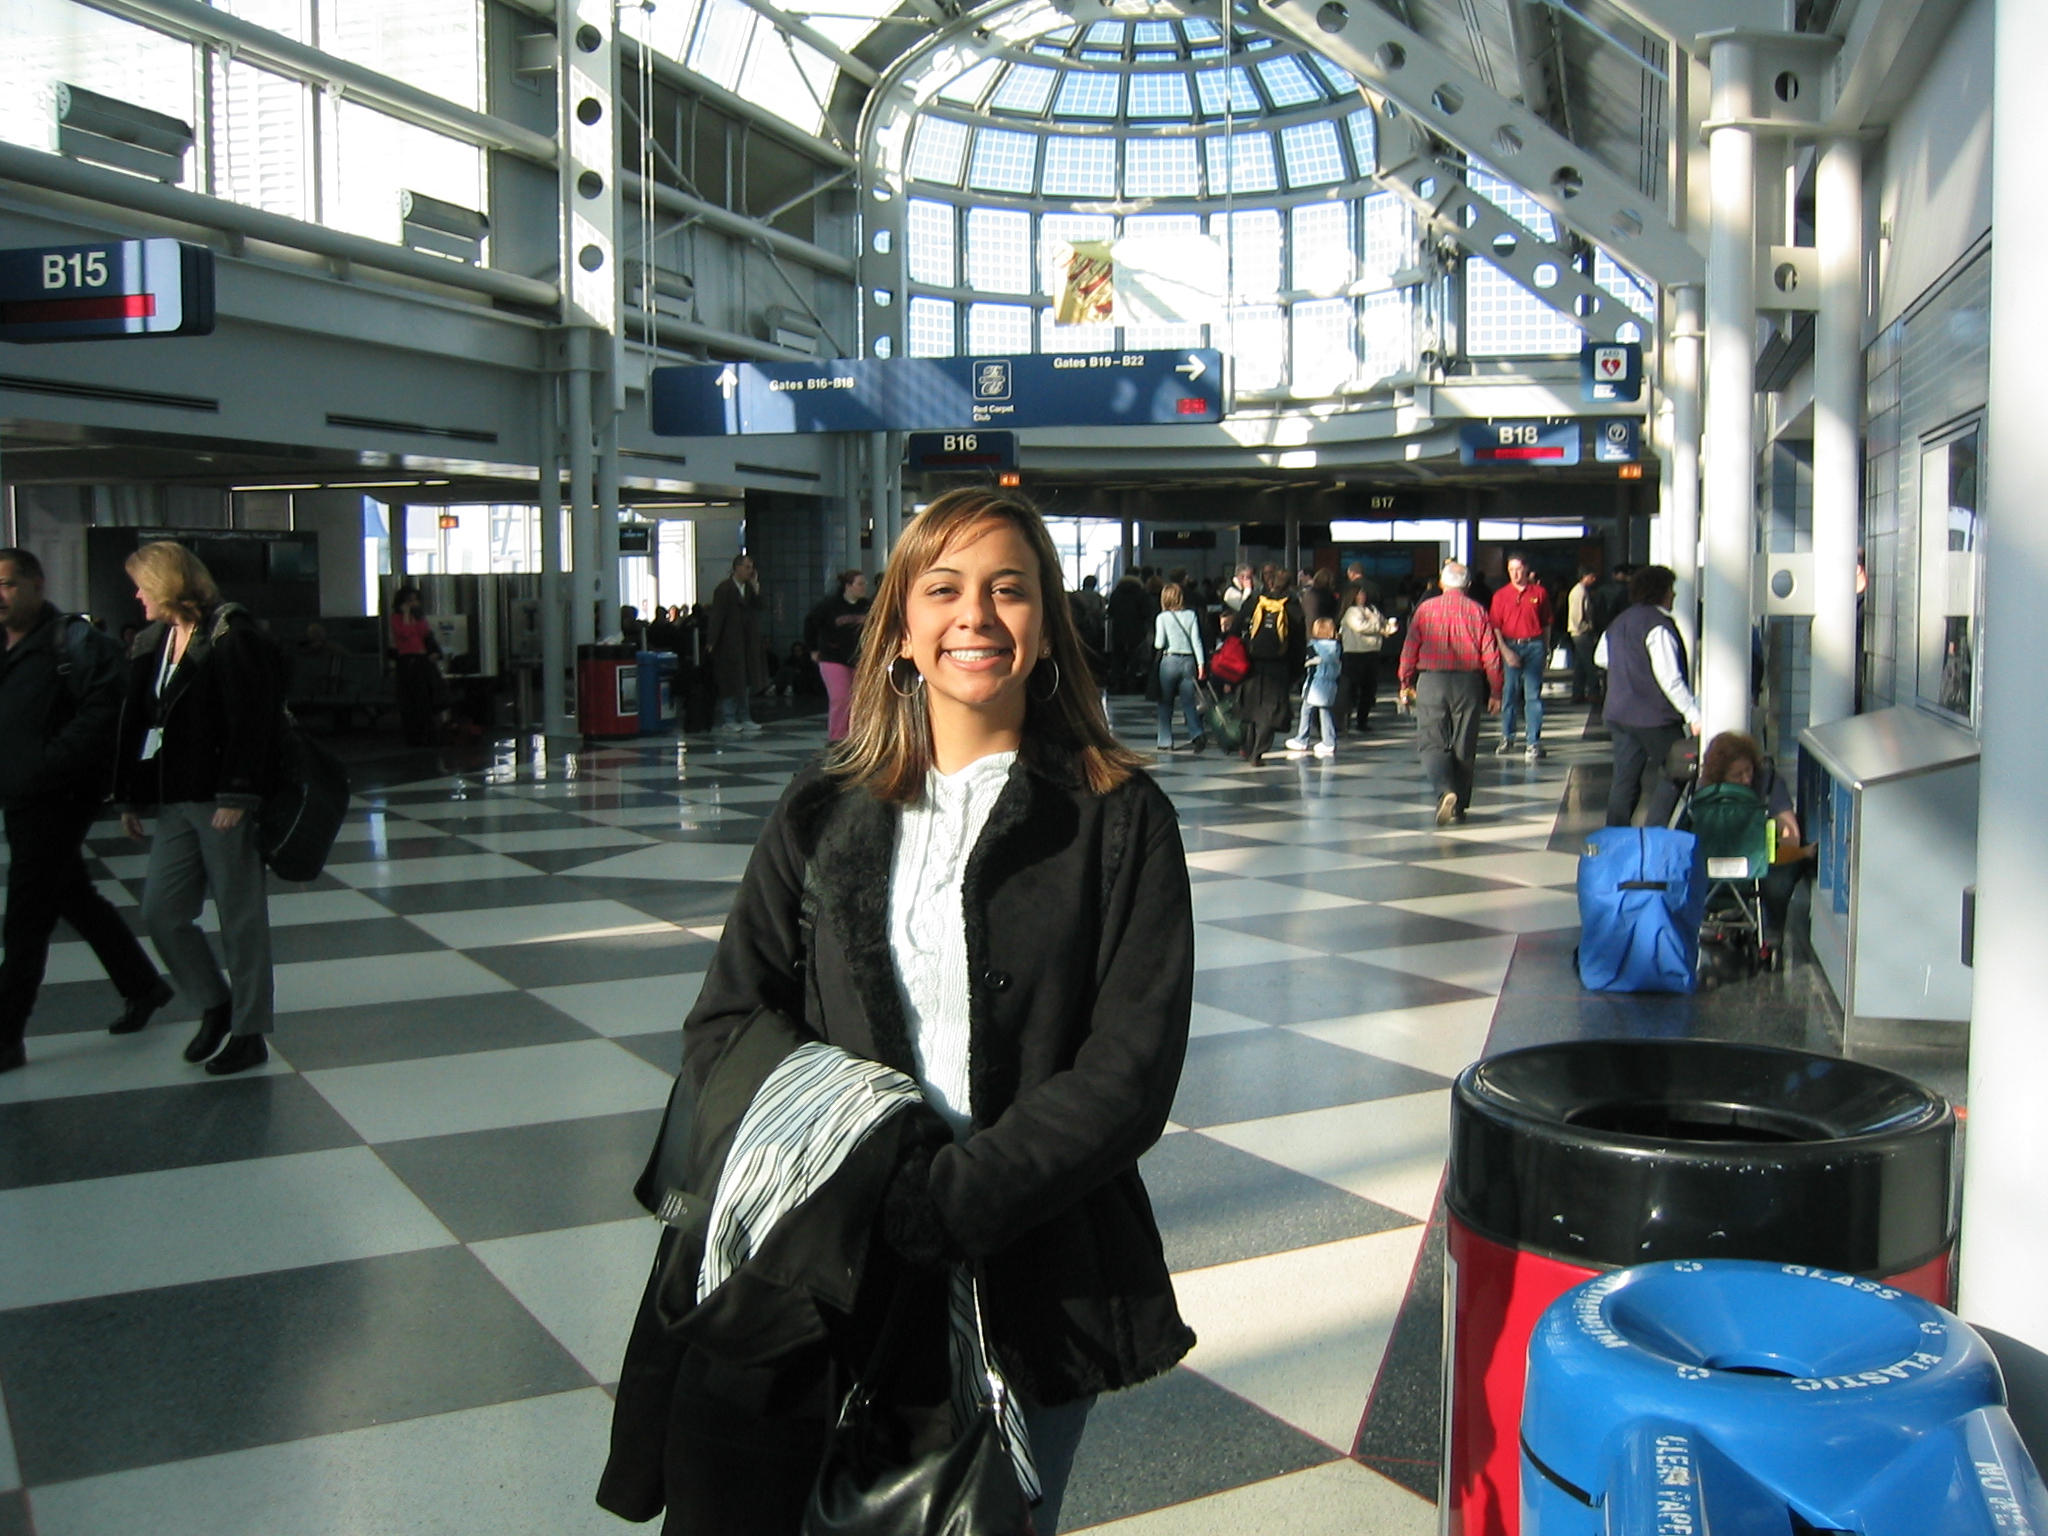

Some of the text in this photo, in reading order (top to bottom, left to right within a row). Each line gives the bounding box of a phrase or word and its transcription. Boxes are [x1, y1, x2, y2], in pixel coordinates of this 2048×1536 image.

[42, 251, 109, 289] B15
[1053, 357, 1087, 369] Gates
[769, 379, 804, 392] Gates
[943, 434, 978, 451] B16
[1499, 426, 1538, 445] B18
[1371, 496, 1395, 508] B17
[1781, 1264, 1902, 1300] GLASS
[1791, 1351, 1943, 1391] PLASTIC
[1657, 1490, 1693, 1536] PAPE
